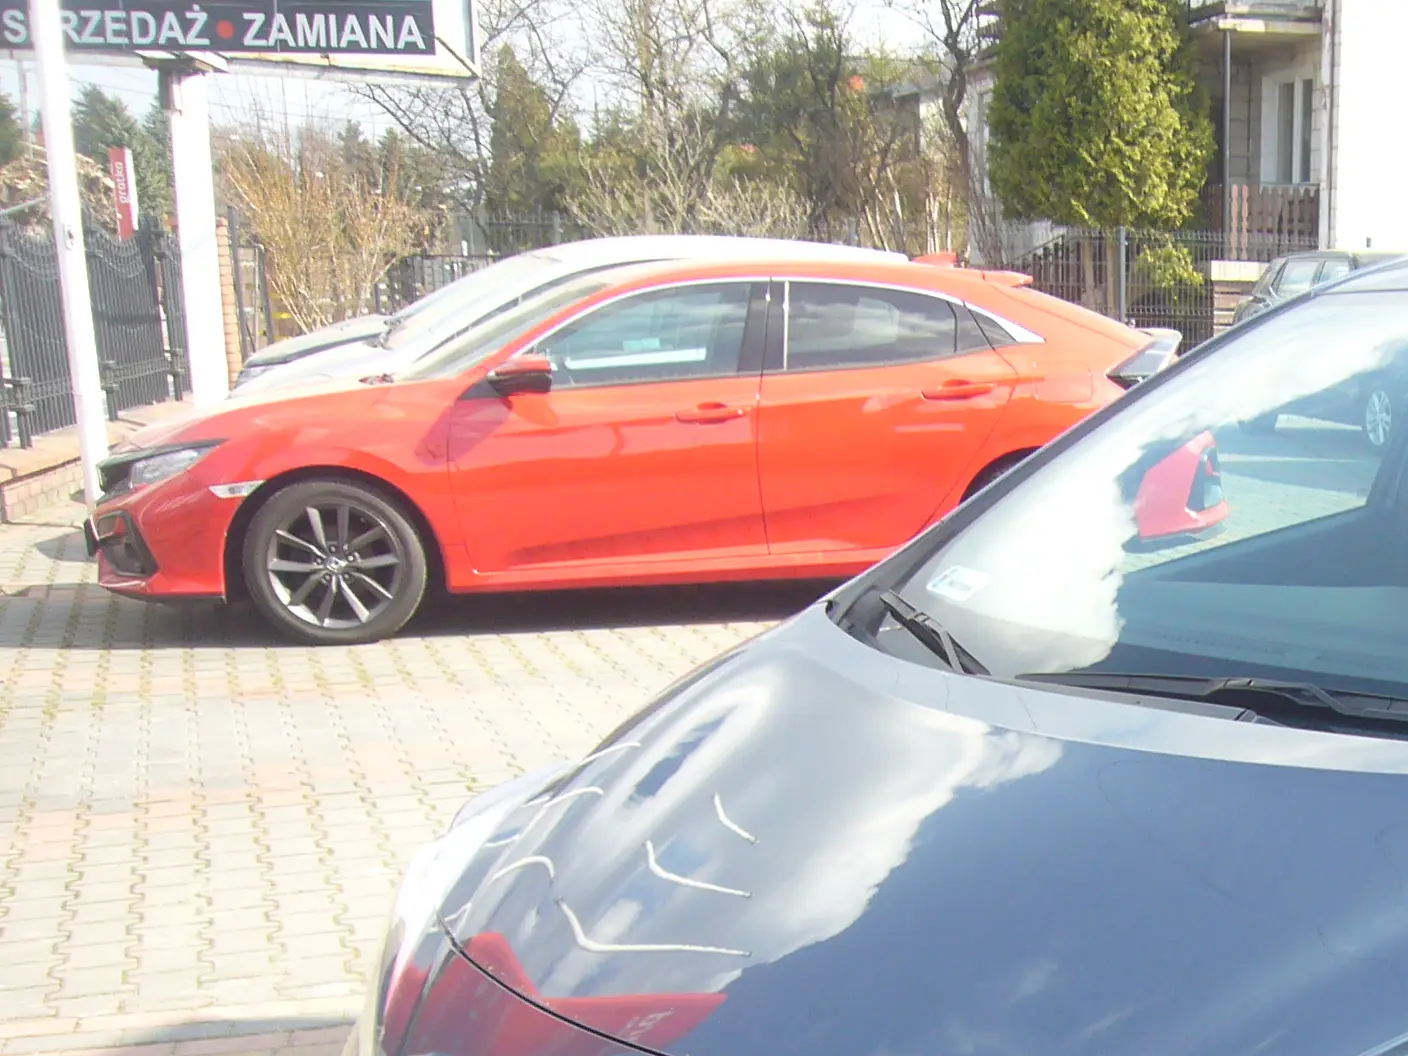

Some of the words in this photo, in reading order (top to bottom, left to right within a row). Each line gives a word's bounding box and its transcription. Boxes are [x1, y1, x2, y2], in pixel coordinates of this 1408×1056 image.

[1, 4, 211, 46] SRZEDAŻ
[242, 11, 427, 50] ZAMIANA
[114, 160, 131, 204] gratka
